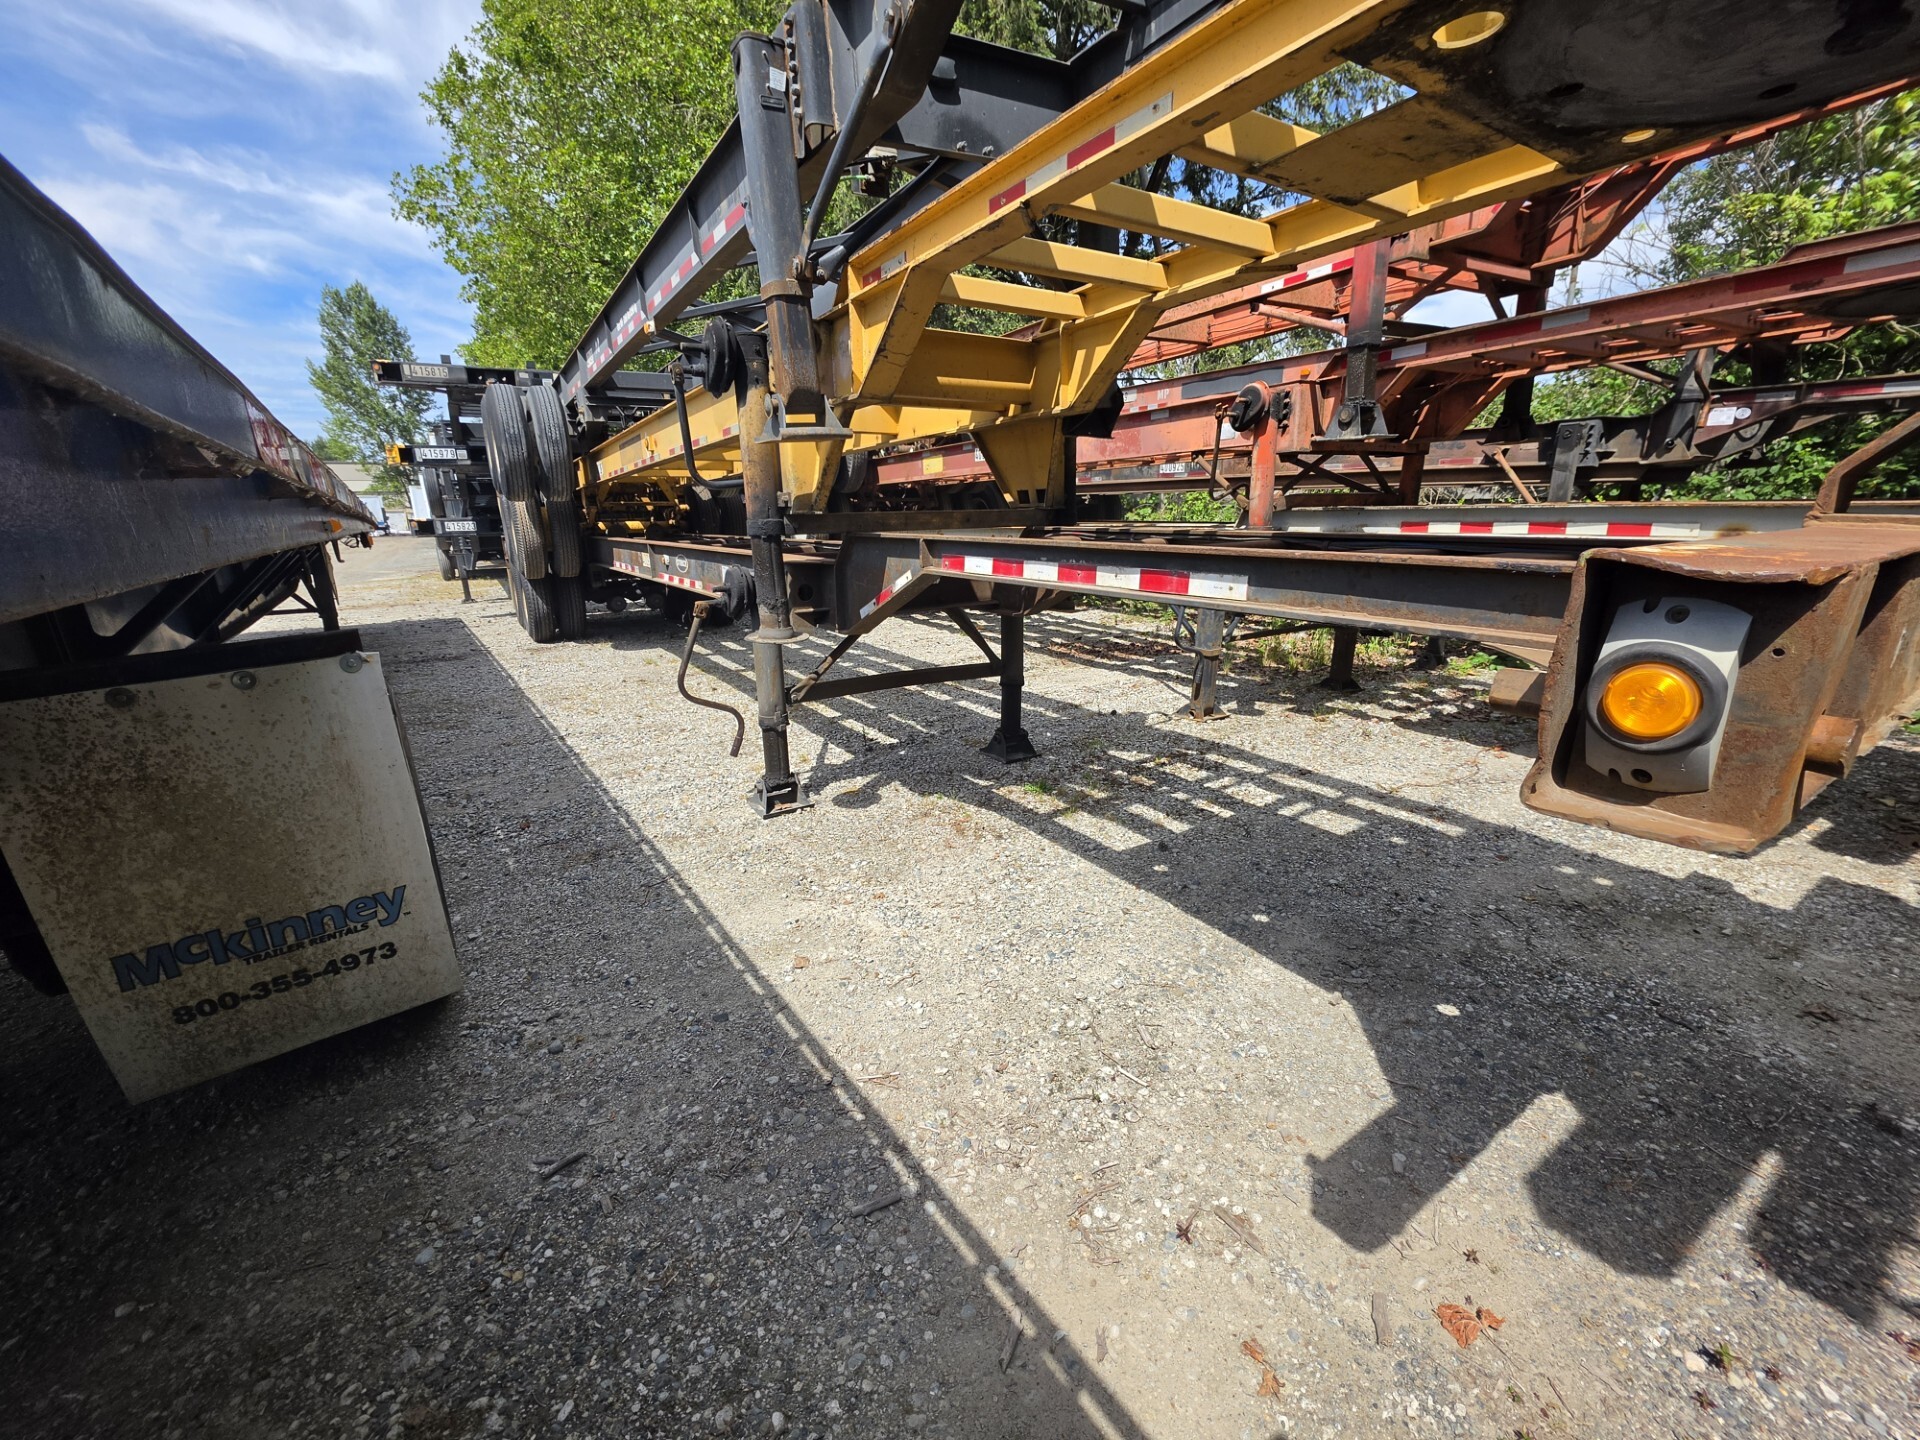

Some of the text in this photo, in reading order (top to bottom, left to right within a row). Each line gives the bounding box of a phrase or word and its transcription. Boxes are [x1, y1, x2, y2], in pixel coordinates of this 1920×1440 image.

[422, 449, 456, 459] 415979
[242, 922, 370, 965] TRAILER RENTALS
[172, 941, 398, 1025] 800-355-4973
